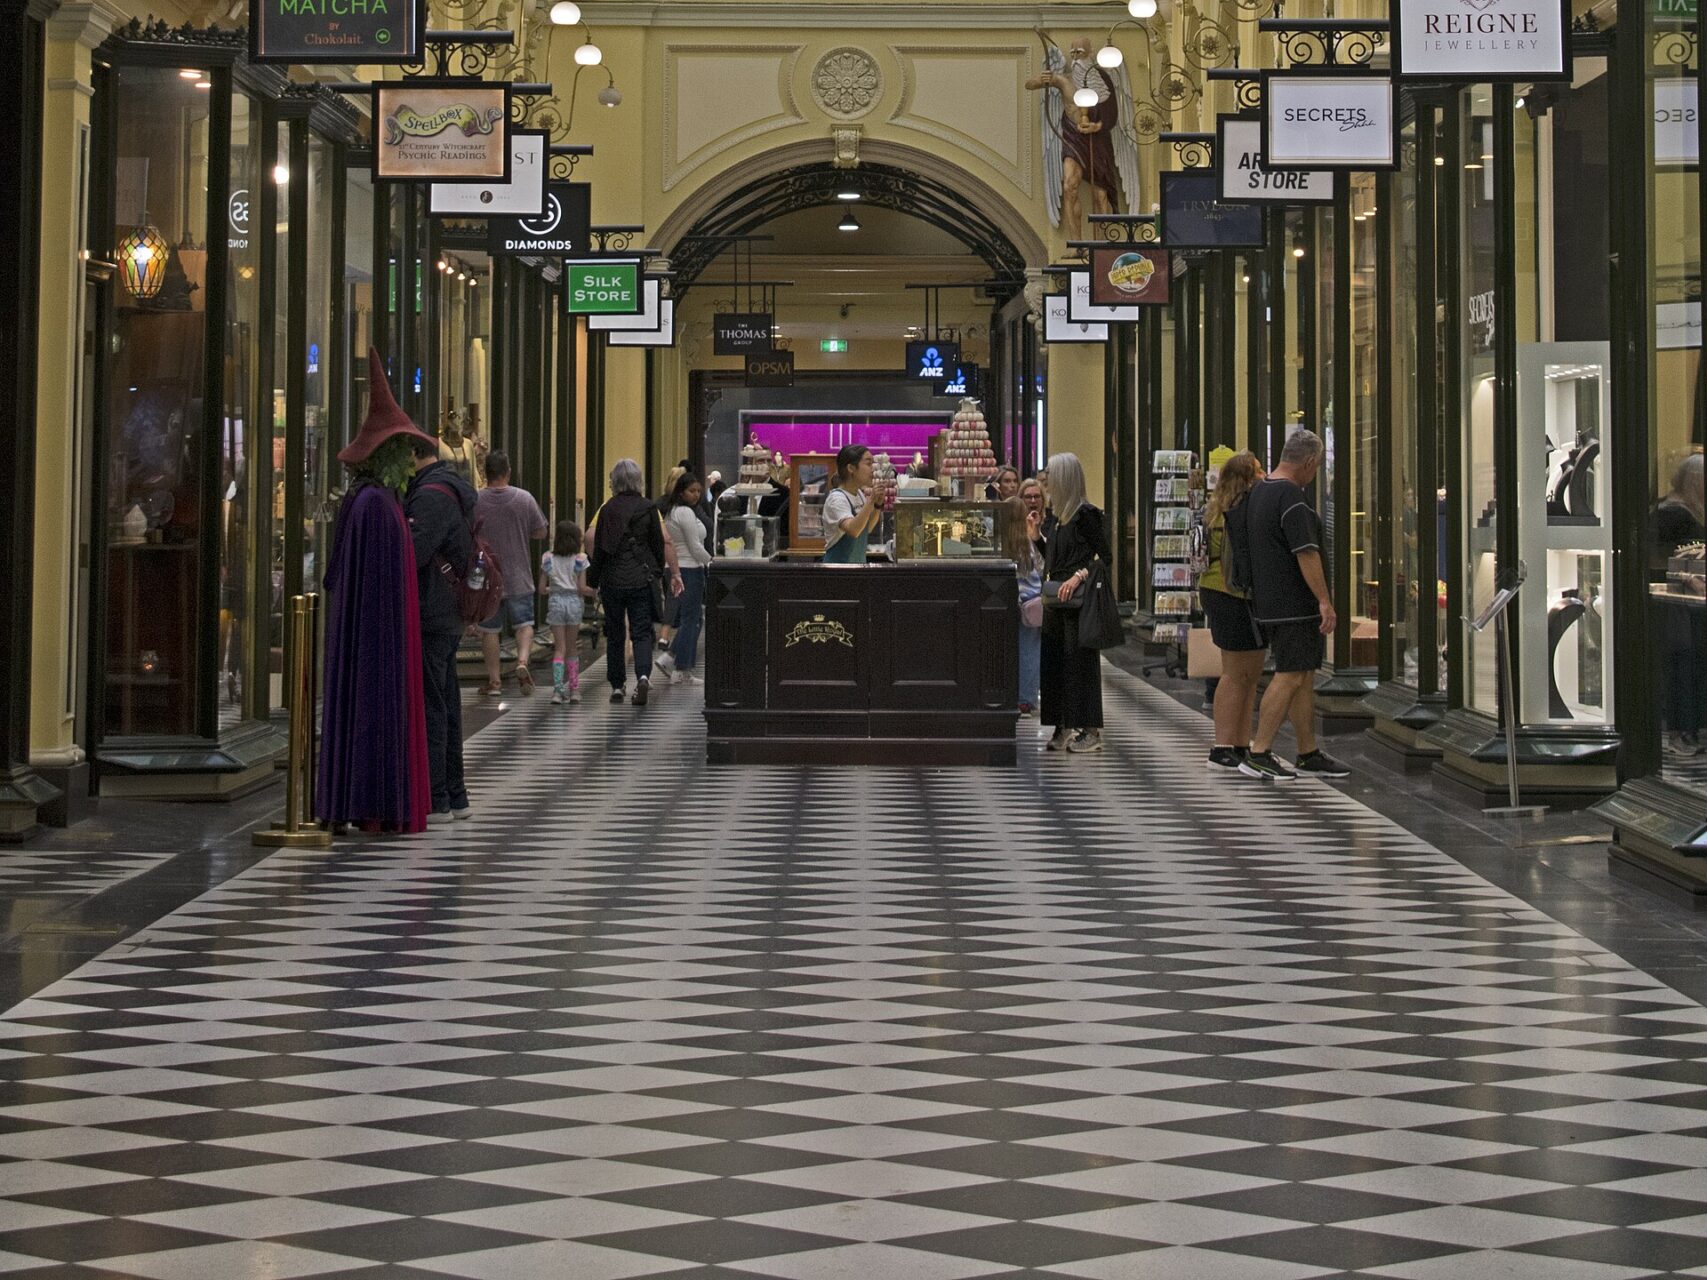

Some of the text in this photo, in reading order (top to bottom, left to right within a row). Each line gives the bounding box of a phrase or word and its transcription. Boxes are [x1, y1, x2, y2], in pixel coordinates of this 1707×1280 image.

[329, 22, 340, 30] BY
[1424, 13, 1538, 34] REIGNE
[1424, 40, 1538, 51] JEWELLERY
[1284, 108, 1367, 122] SECRETS
[1248, 171, 1310, 189] STORE
[505, 240, 572, 250] DIAMONDS
[584, 276, 622, 287] SILK
[574, 290, 631, 301] STORE
[720, 329, 767, 339] THOMAS
[749, 362, 791, 375] OPSM
[919, 367, 944, 377] ANZ
[944, 384, 966, 394] ANZ
